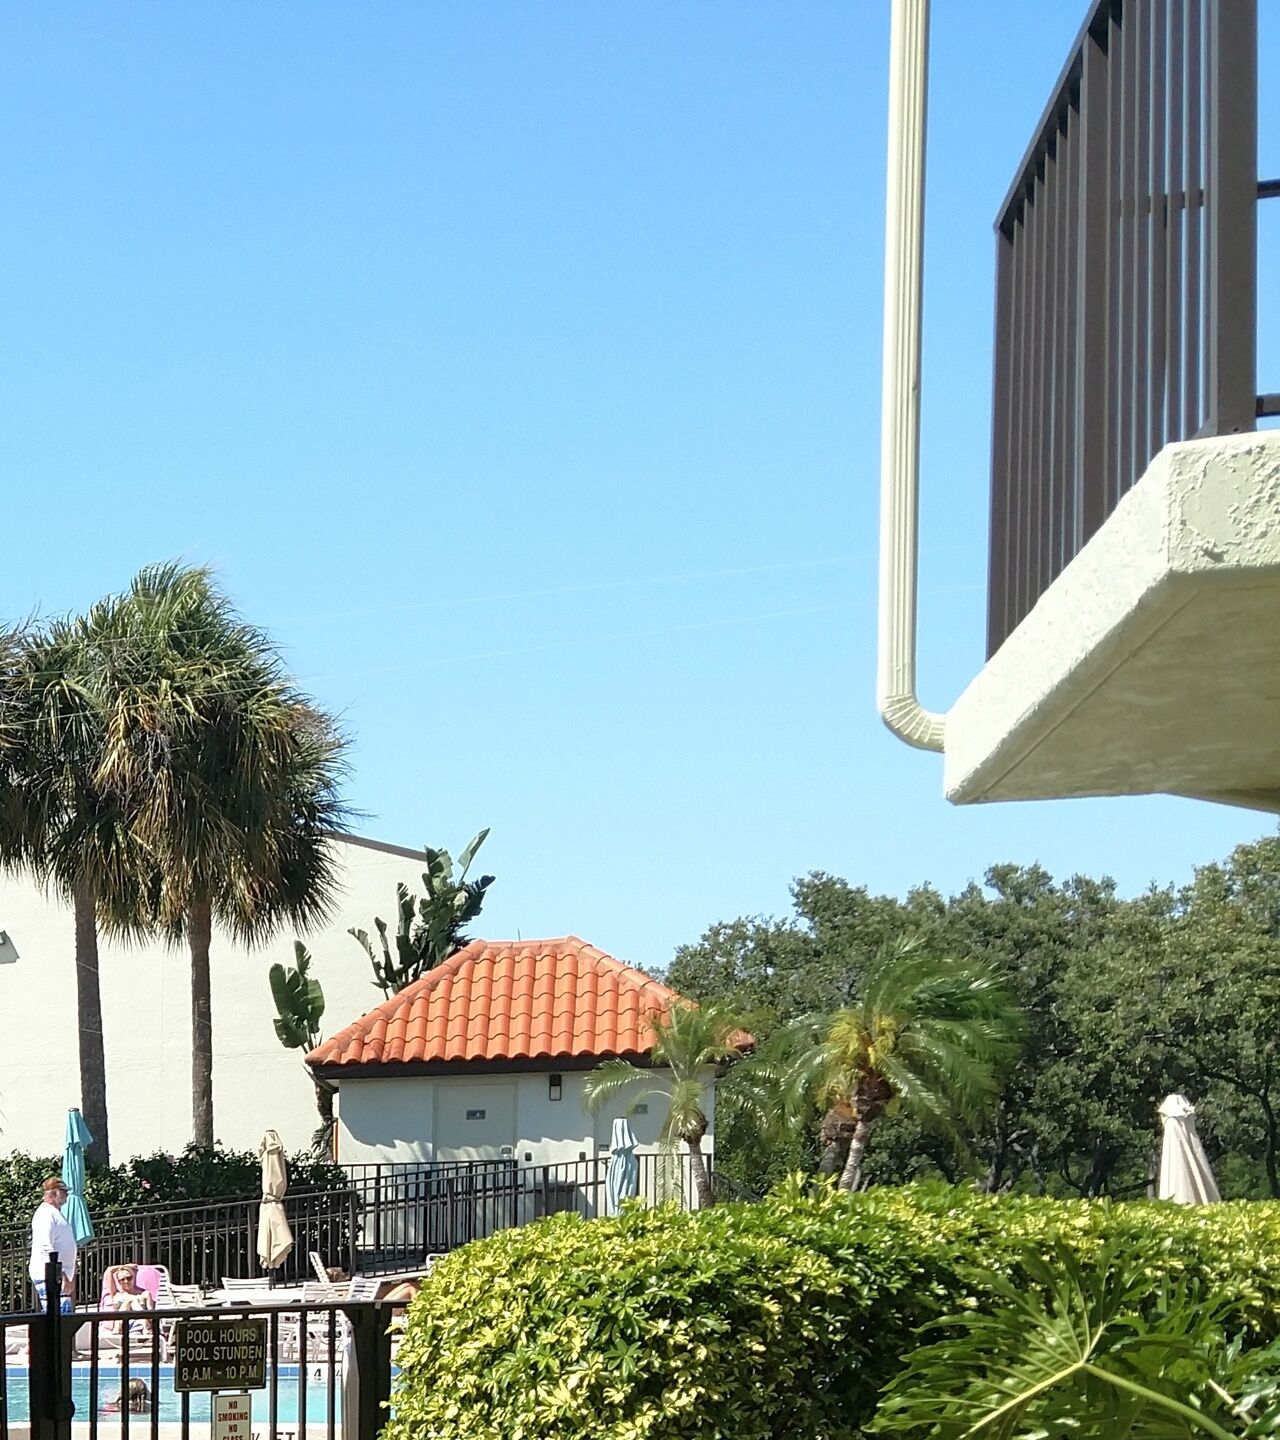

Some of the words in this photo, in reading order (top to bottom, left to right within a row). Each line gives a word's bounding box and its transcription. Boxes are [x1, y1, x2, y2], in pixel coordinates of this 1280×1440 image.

[186, 1329, 216, 1344] POOL
[220, 1327, 256, 1342] HOURS
[180, 1347, 210, 1361] POOL
[212, 1345, 262, 1360] STUNDEN
[182, 1367, 189, 1381] 8
[225, 1365, 237, 1379] 10
[228, 1401, 238, 1410] NO
[218, 1411, 248, 1422] SMOKING
[228, 1424, 238, 1433] NO
